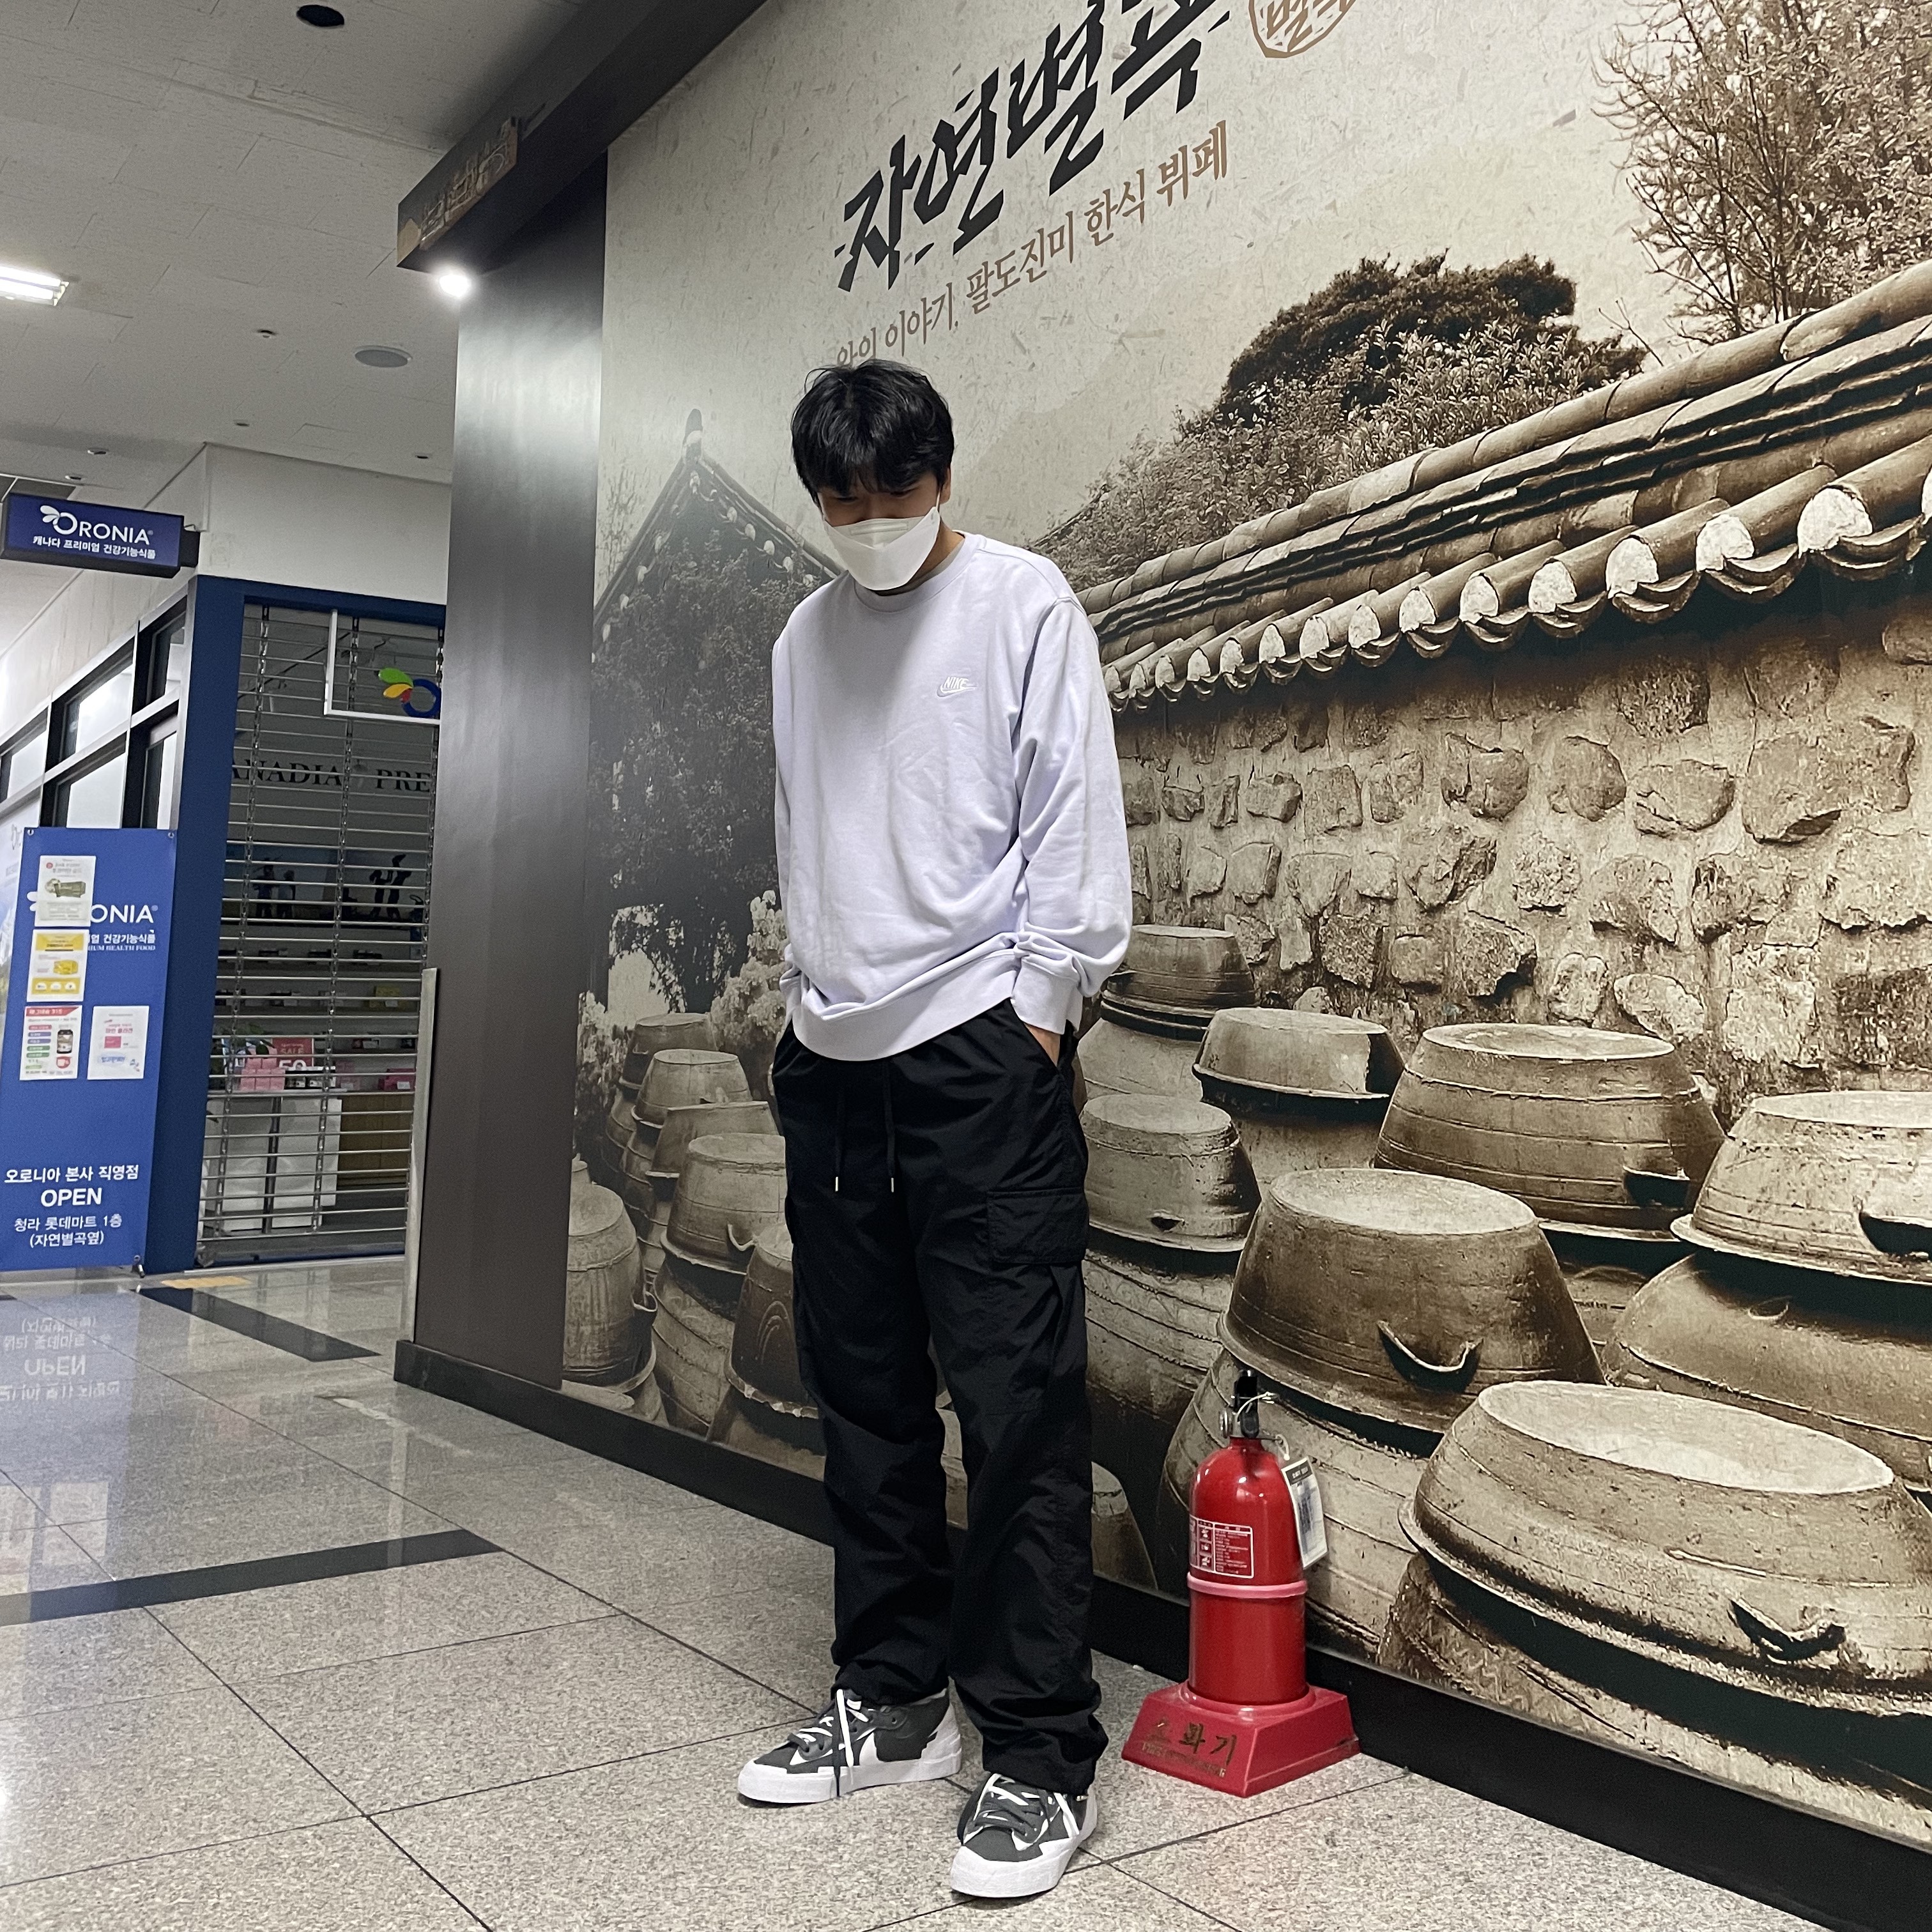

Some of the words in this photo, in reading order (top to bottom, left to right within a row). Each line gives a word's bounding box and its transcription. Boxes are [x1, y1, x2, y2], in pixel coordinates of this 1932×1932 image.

[966, 211, 1073, 314] 팔도진미
[1084, 168, 1145, 247] 한식
[1156, 119, 1227, 207] 뷔페
[53, 512, 150, 545] ORONIA
[33, 535, 61, 548] 캐나다
[63, 540, 100, 553] 프리미엄
[103, 544, 156, 560] 건강기능식품
[944, 677, 969, 689] NIKE
[90, 904, 154, 923] ONIA
[103, 934, 156, 944] 건강기능식품
[4, 1168, 61, 1183] 오로니아
[65, 1166, 93, 1182] 본사
[98, 1165, 139, 1180] 직영점
[41, 1188, 102, 1207] OPEN
[14, 1218, 40, 1232] 청라
[45, 1216, 96, 1230] 롯데마트
[103, 1213, 122, 1228] 1층
[29, 1230, 104, 1248] (자연별곡옆)
